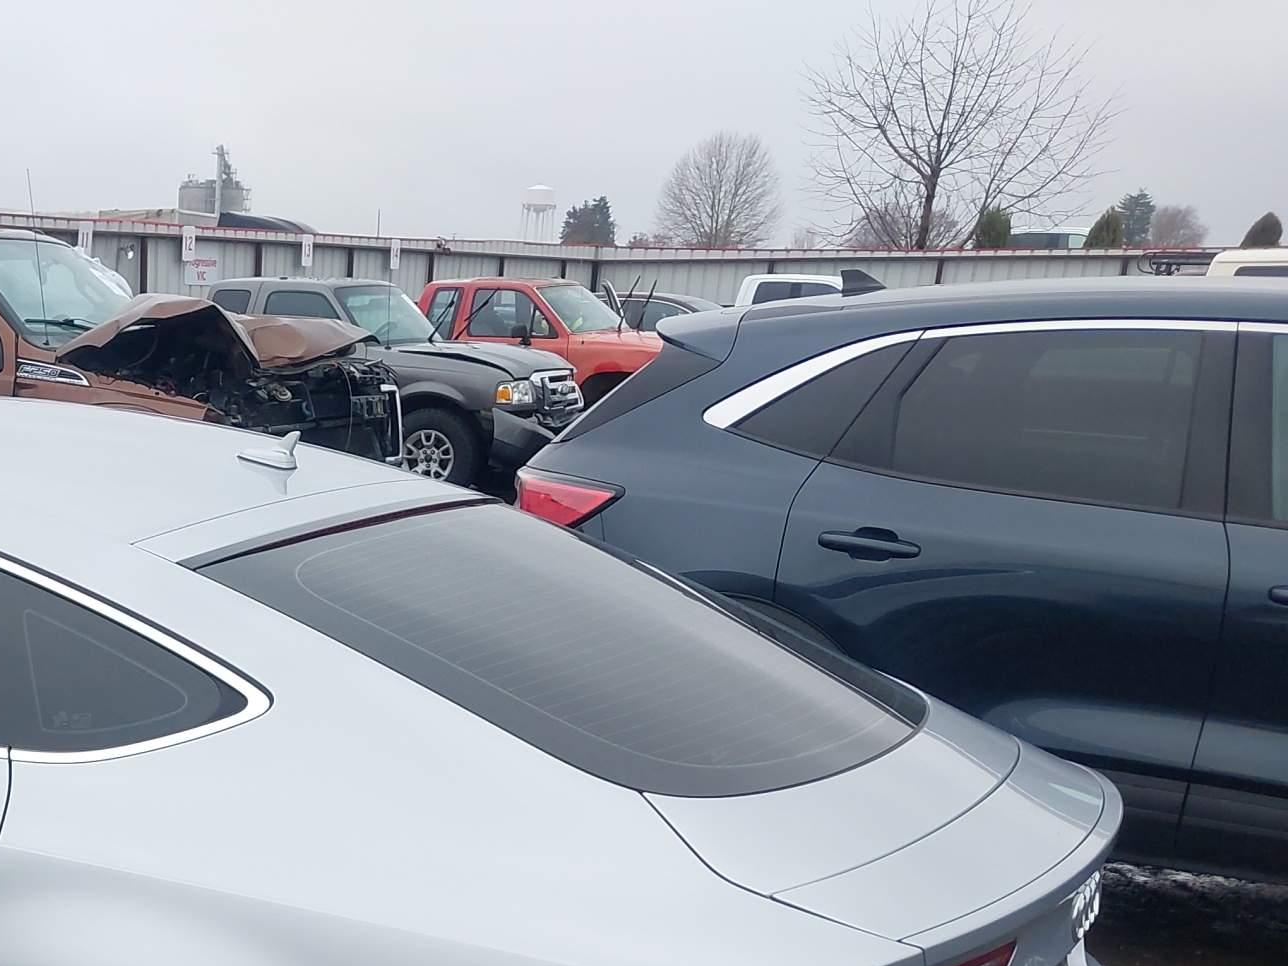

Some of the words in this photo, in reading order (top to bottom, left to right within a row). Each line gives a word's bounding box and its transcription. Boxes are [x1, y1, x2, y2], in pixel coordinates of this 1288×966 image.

[80, 231, 90, 249] 11
[184, 235, 194, 252] 12
[304, 242, 311, 258] 13
